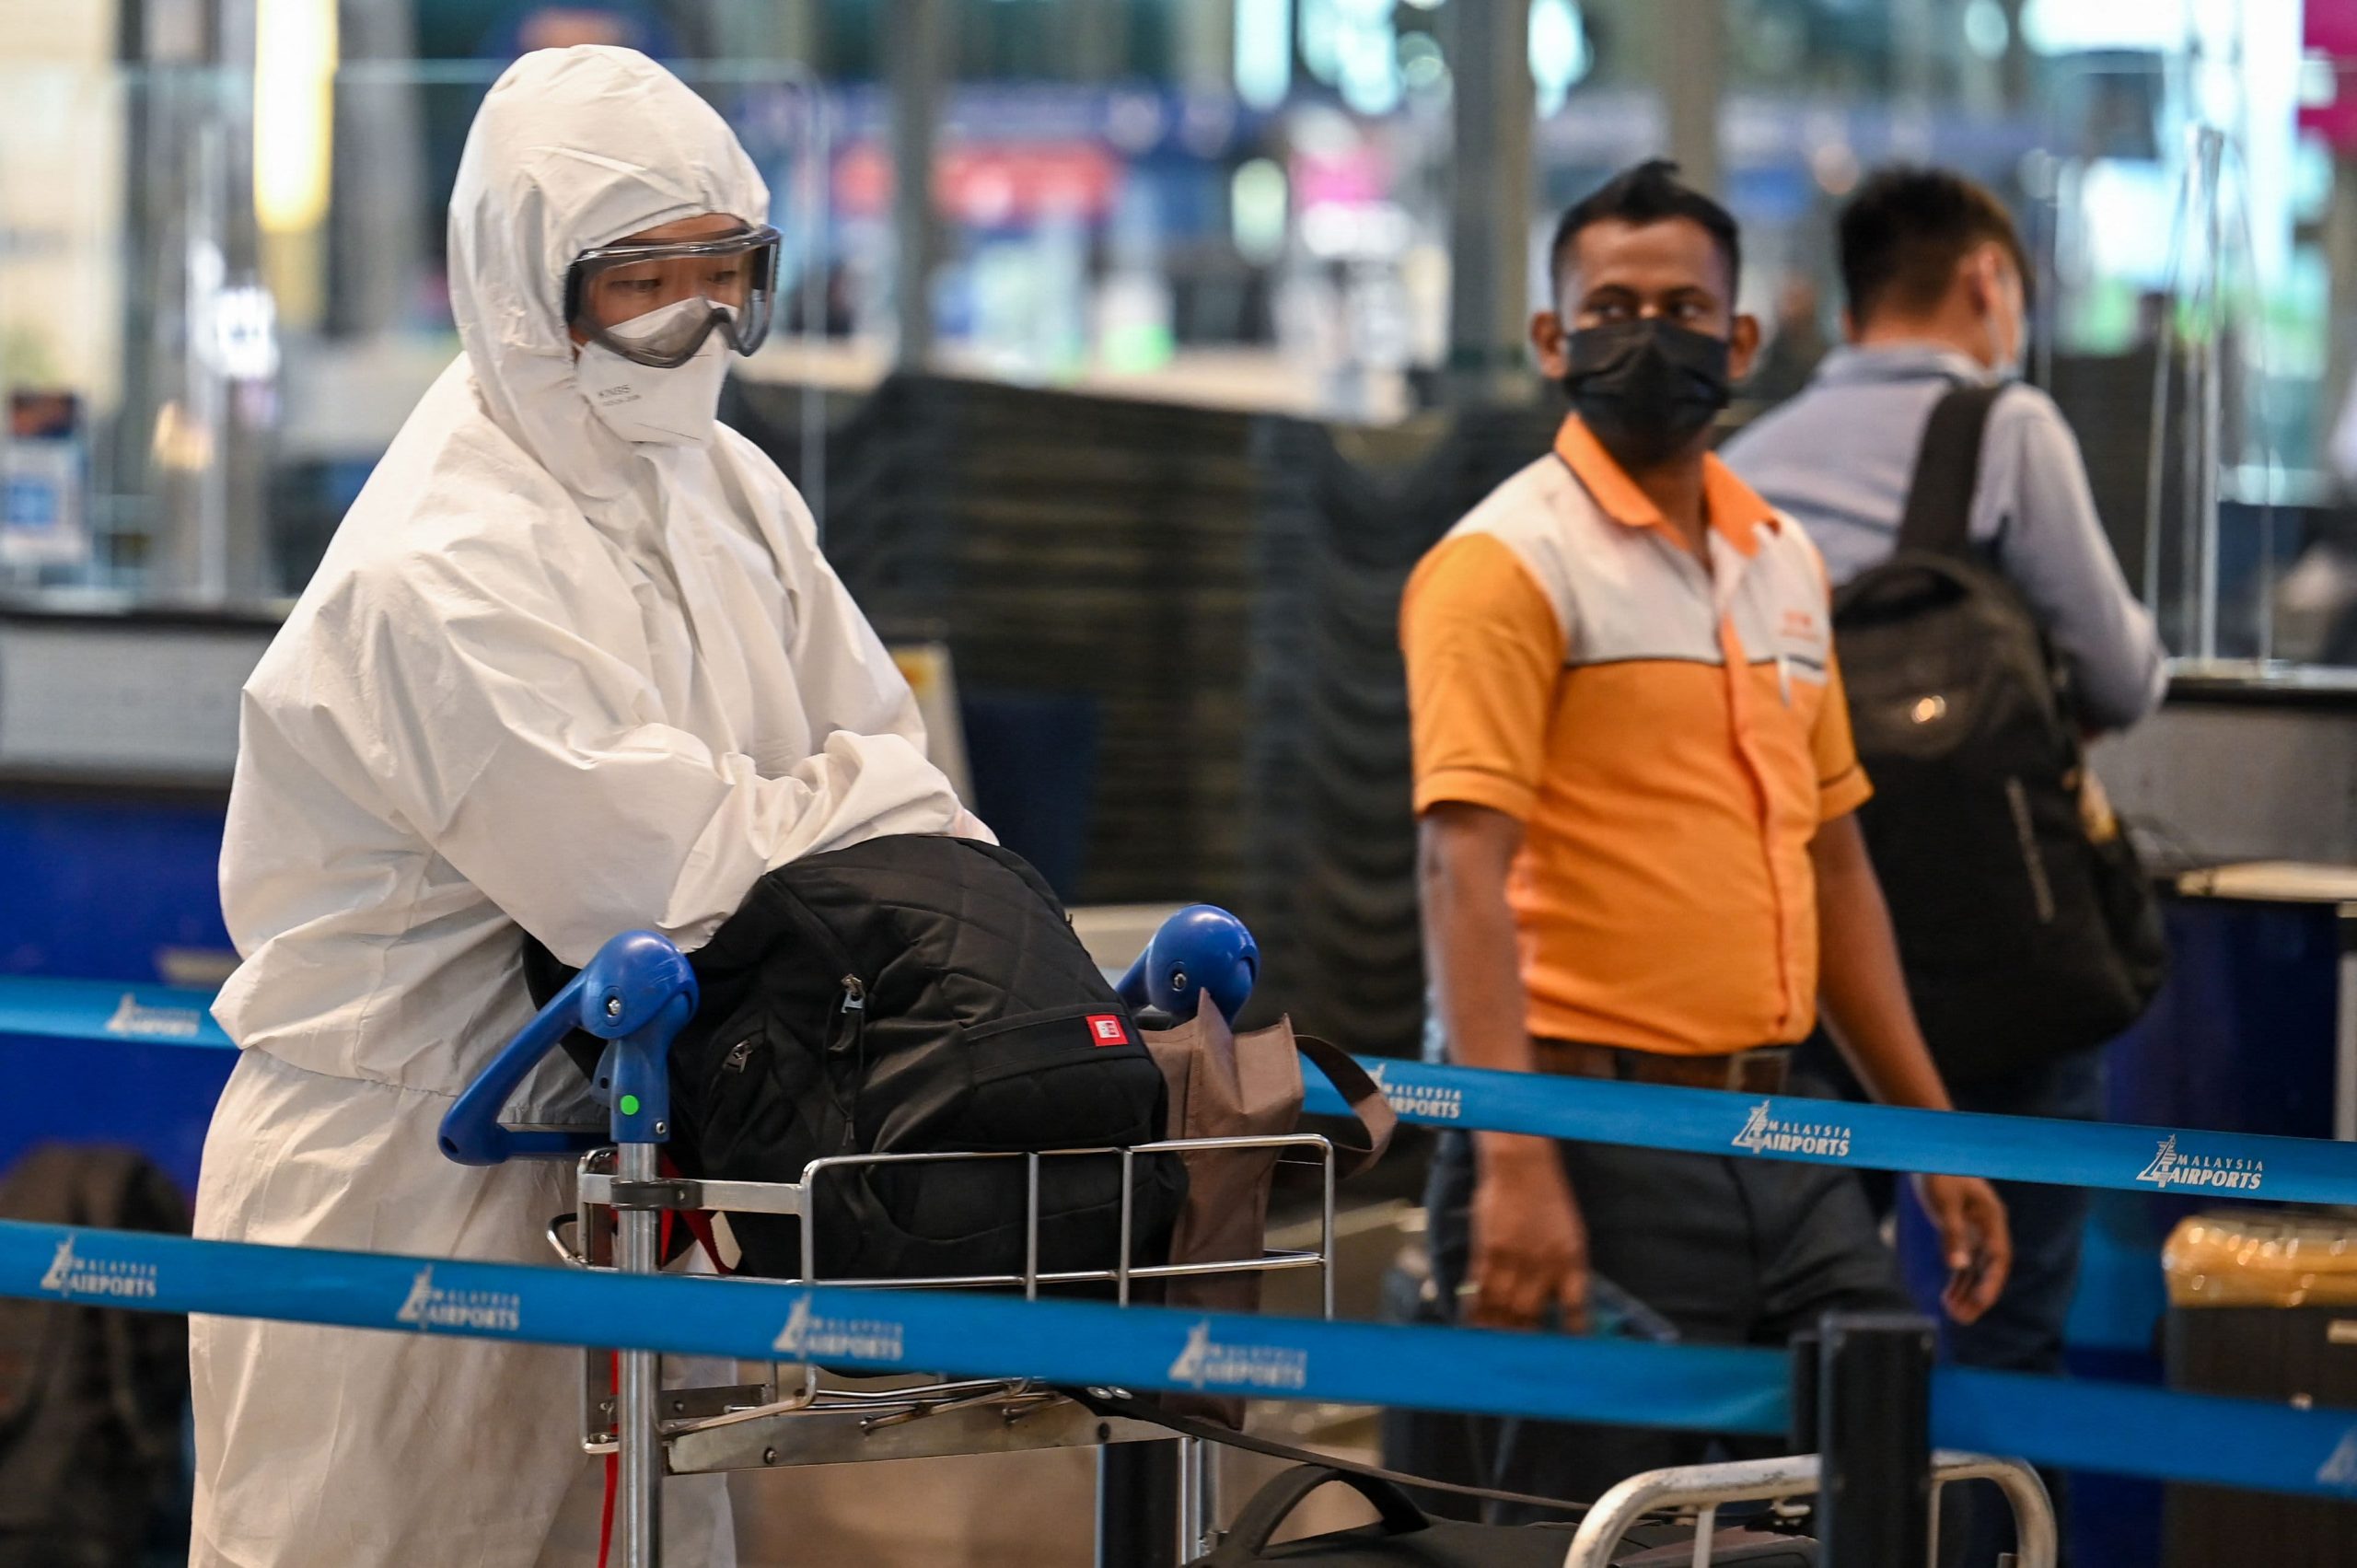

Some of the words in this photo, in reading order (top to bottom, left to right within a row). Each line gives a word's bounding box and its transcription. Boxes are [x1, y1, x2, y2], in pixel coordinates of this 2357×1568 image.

[1383, 1082, 1462, 1101] MALAYSIA
[1387, 1096, 1461, 1120] IRPORTS
[1768, 1120, 1851, 1139] MALAYSIA
[1760, 1132, 1851, 1157] AIRPORTS
[2177, 1154, 2264, 1172] MALAYSIA
[2166, 1167, 2262, 1191] AIRPORTS
[74, 1256, 157, 1277] MALAYSIA
[71, 1272, 157, 1297] AIRPORTS
[428, 1306, 520, 1331] AIRPORTS
[807, 1335, 903, 1361] AIRPORTS
